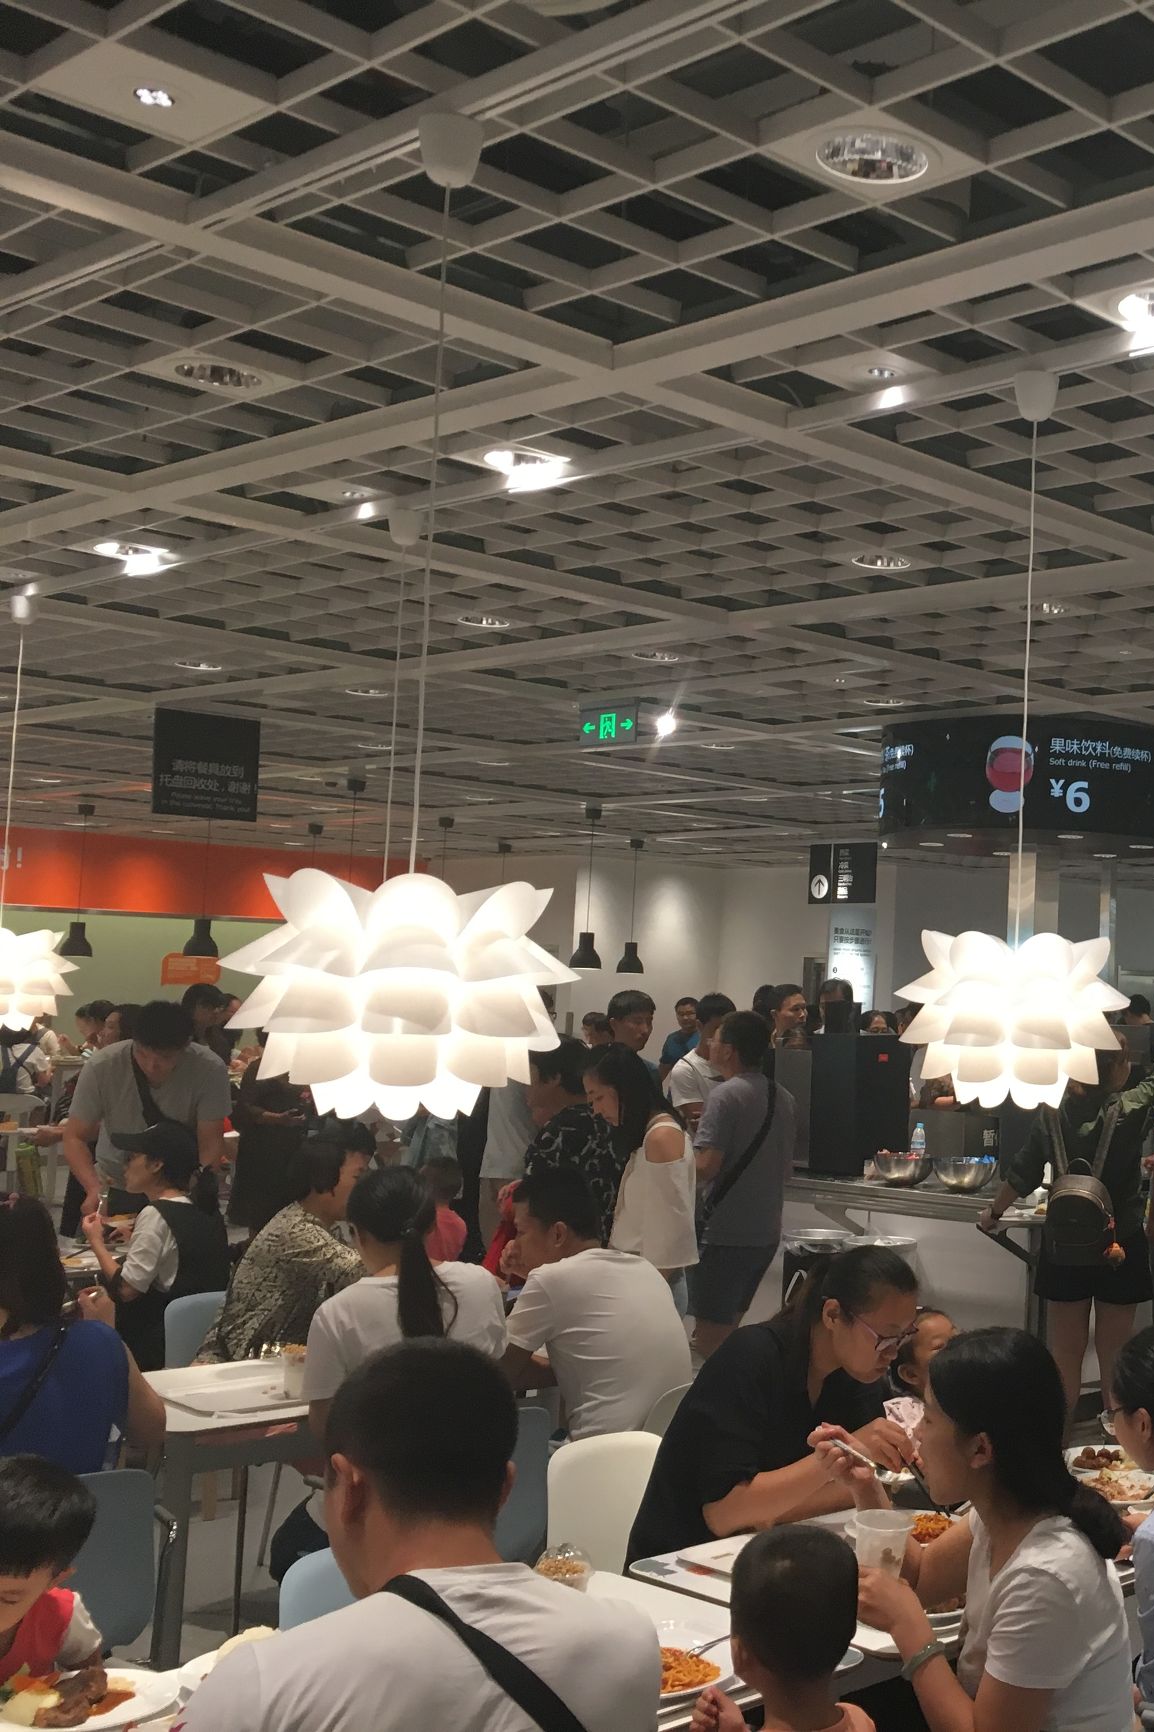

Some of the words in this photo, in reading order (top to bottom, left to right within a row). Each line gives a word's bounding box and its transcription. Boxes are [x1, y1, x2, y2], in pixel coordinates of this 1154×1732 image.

[1049, 757, 1065, 766] Soft
[1067, 759, 1087, 767] drink
[1089, 759, 1110, 769] (Free
[1112, 761, 1131, 773] refill)
[1049, 778, 1091, 813] ¥6
[982, 1129, 998, 1147] 暂
